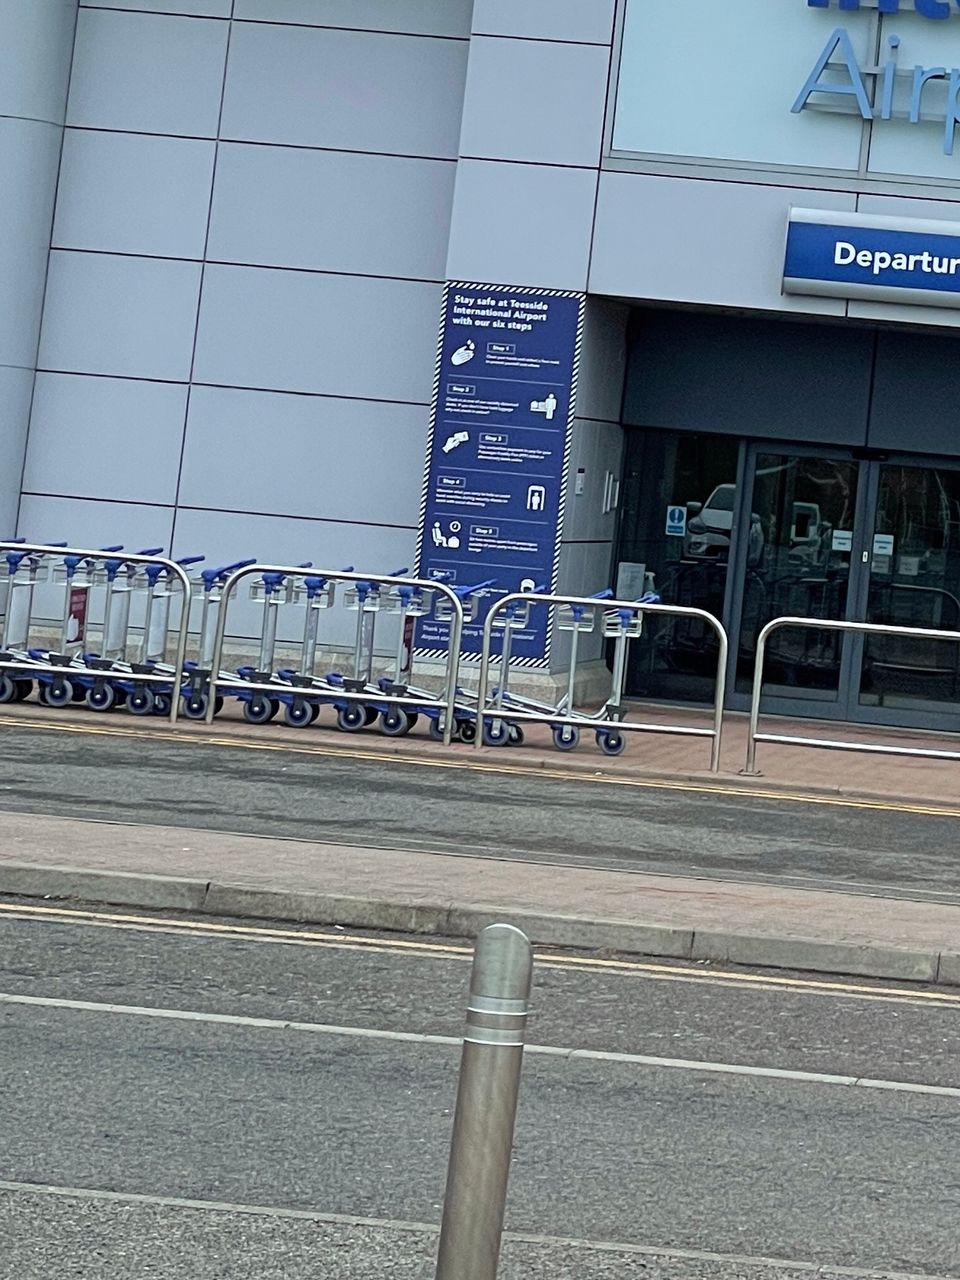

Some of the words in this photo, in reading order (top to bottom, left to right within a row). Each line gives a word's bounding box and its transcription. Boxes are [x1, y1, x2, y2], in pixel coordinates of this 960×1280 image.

[454, 295, 474, 306] Stay
[477, 298, 495, 307] safe
[510, 300, 548, 311] Teesside
[453, 306, 511, 318] International
[513, 310, 547, 321] Airport
[452, 317, 473, 326] with
[492, 320, 506, 329] six
[507, 322, 532, 332] steps
